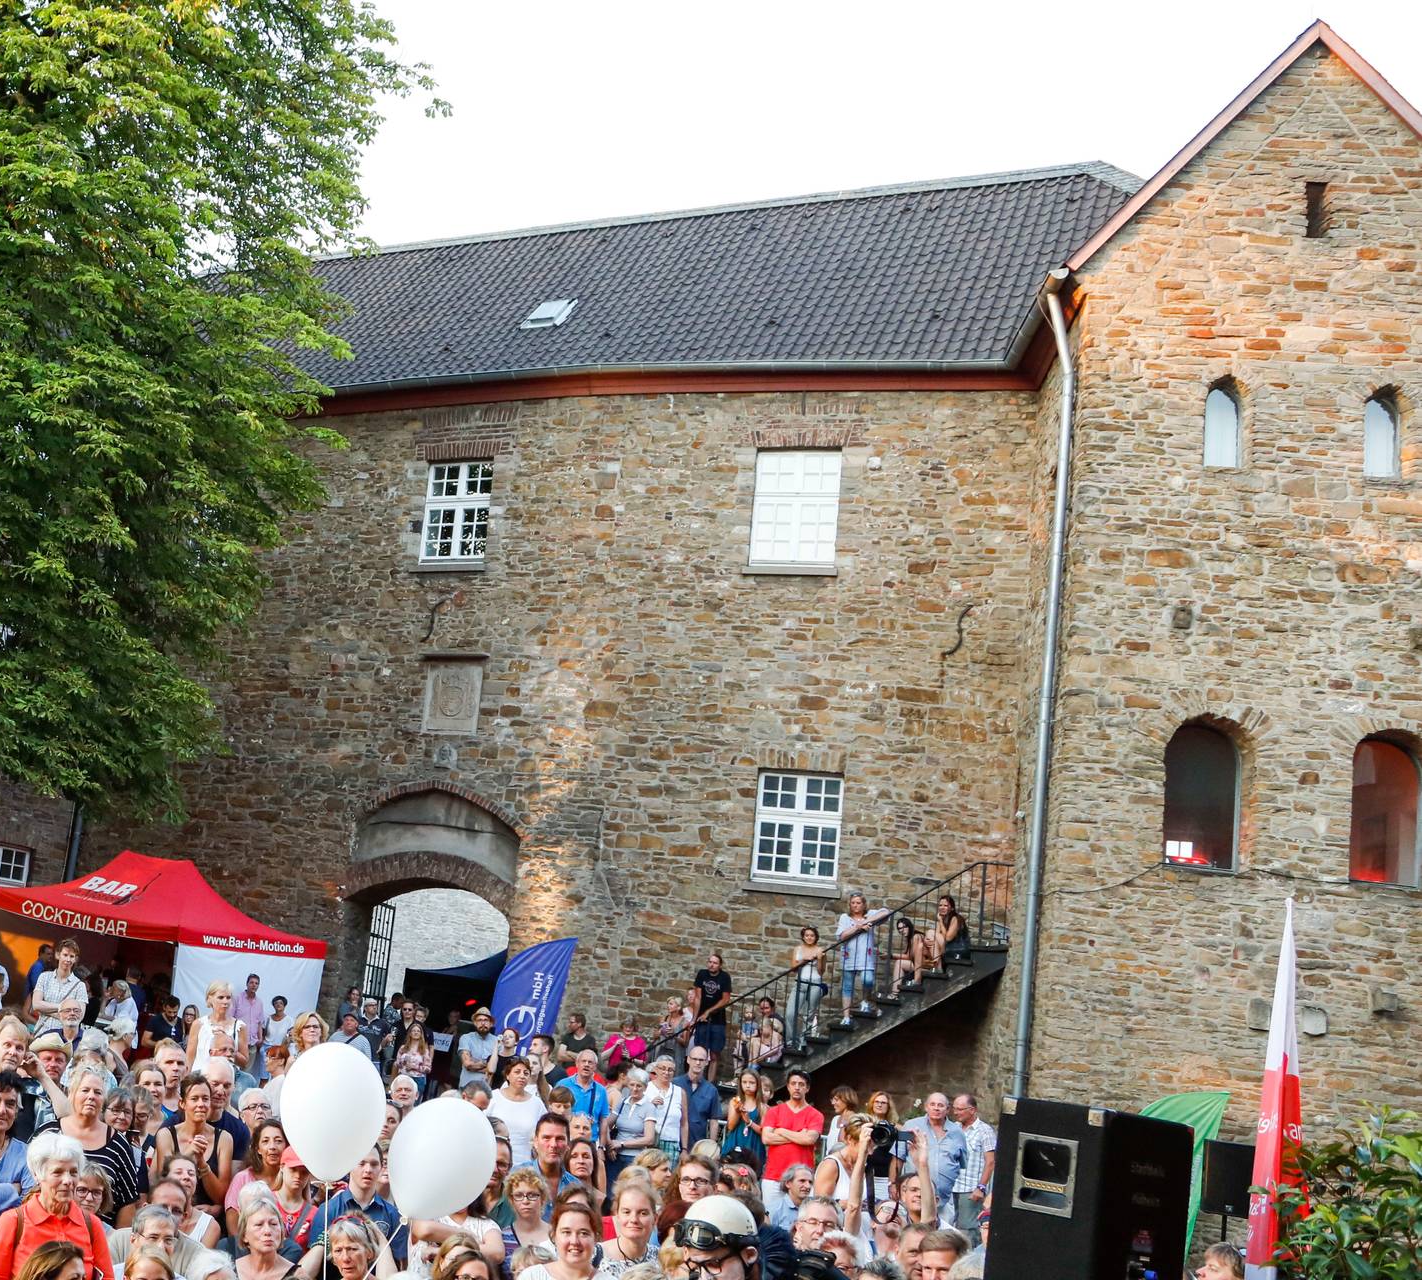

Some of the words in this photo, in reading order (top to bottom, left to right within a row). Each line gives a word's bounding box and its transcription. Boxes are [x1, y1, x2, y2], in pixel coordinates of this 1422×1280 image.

[79, 876, 139, 898] BAR
[21, 900, 128, 936] COCKTAILBAR
[203, 935, 305, 954] www.Bar-In-Motion.de
[532, 972, 545, 1000] mbH
